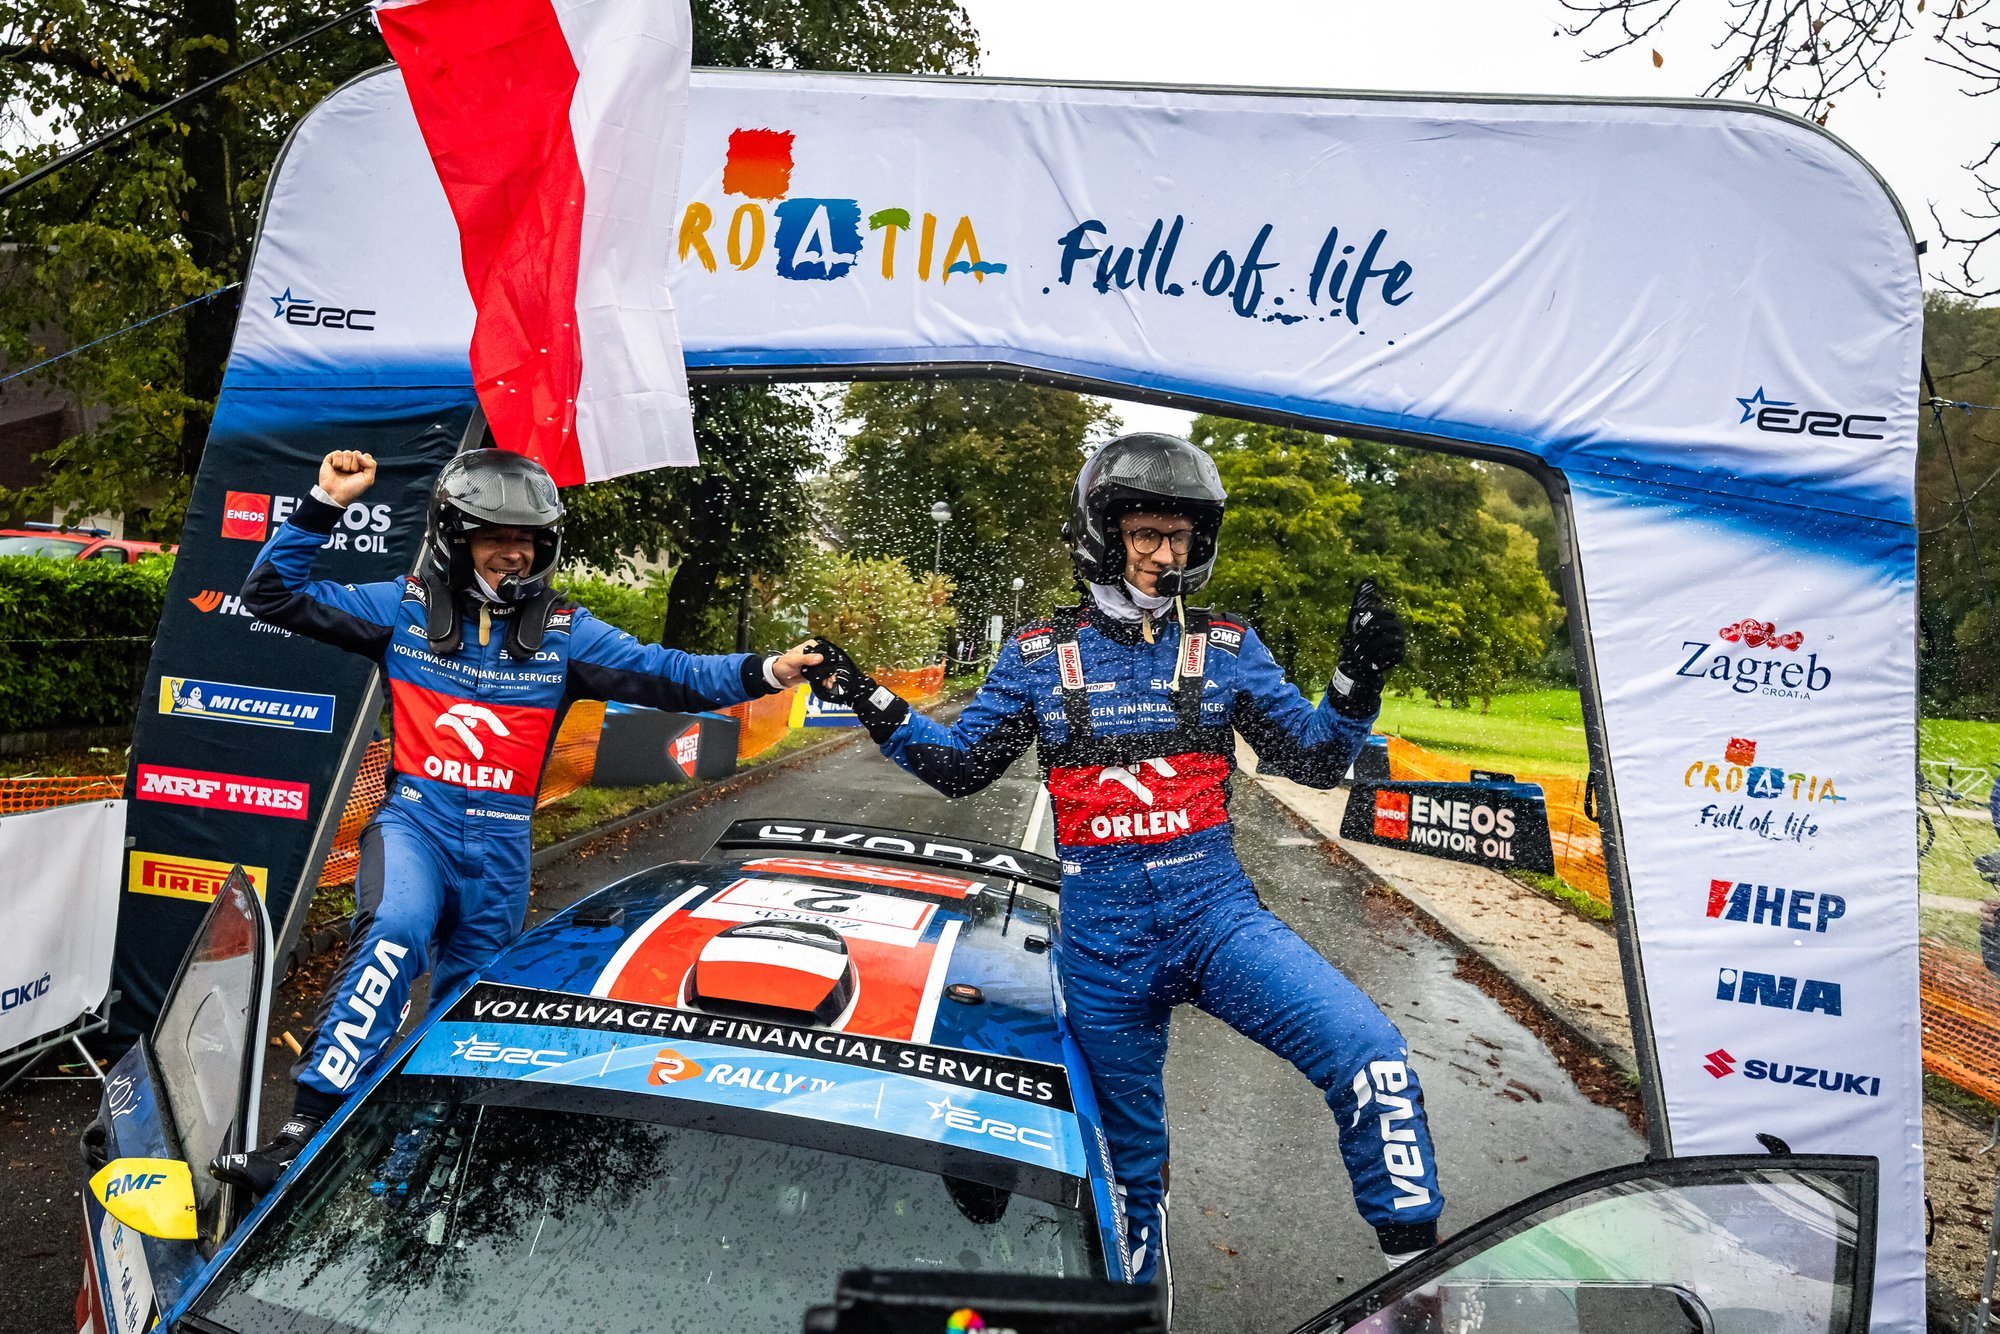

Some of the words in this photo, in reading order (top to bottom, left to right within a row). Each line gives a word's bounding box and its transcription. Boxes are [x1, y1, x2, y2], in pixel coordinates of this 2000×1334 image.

[678, 200, 1007, 285] ROATIA
[1058, 214, 1184, 296] Full
[1200, 223, 1280, 320] of
[1309, 226, 1414, 325] life
[286, 304, 376, 331] ERC
[1756, 407, 1887, 440] ERC
[226, 509, 265, 522] ENEOS
[272, 495, 391, 533] EOS
[354, 535, 388, 553] OIL
[406, 582, 427, 601] OM
[250, 620, 292, 638] driving
[1210, 630, 1240, 644] OMP
[1022, 638, 1050, 652] OMP
[1188, 638, 1200, 671] SIMPSON
[393, 643, 460, 671] VOLKSWAGEN
[462, 665, 516, 681] FINANCIAL
[518, 672, 562, 684] SERVICES
[1064, 649, 1078, 684] SIMPSON
[1676, 641, 1832, 694] Zagreb
[209, 695, 319, 719] MICHELIN
[1118, 702, 1174, 715] FINANCIAL
[1762, 687, 1810, 700] CROATIA
[676, 733, 699, 751] WEST
[677, 750, 697, 765] GATE
[424, 755, 514, 790] ORLEN
[1684, 760, 1847, 804] CROATIA
[141, 773, 221, 799] MRF
[225, 783, 303, 811] TYRES
[401, 785, 422, 800] OMP
[476, 809, 485, 817] SZ
[1090, 809, 1190, 839] ORLEN
[1377, 807, 1406, 820] ENEOS
[1411, 795, 1516, 838] ENEOS
[1700, 804, 1743, 830] Full
[1750, 810, 1775, 838] of
[1785, 812, 1819, 843] life
[1411, 826, 1477, 854] MOTOR
[1482, 838, 1515, 861] OIL
[142, 860, 255, 896] PIREL
[793, 888, 862, 912] 2
[1752, 884, 1847, 933] HEP
[0, 971, 51, 1011] OKIĆ
[464, 1041, 568, 1067] ERC
[473, 1000, 698, 1034] VOLKSWAGEN
[707, 1020, 886, 1065] FINANCIAL
[897, 1050, 1053, 1101] SERVICES
[1743, 1058, 1881, 1097] SUZUKI
[283, 1124, 304, 1134] OMP
[945, 1109, 1053, 1151] ERC
[105, 1174, 167, 1203] RMF
